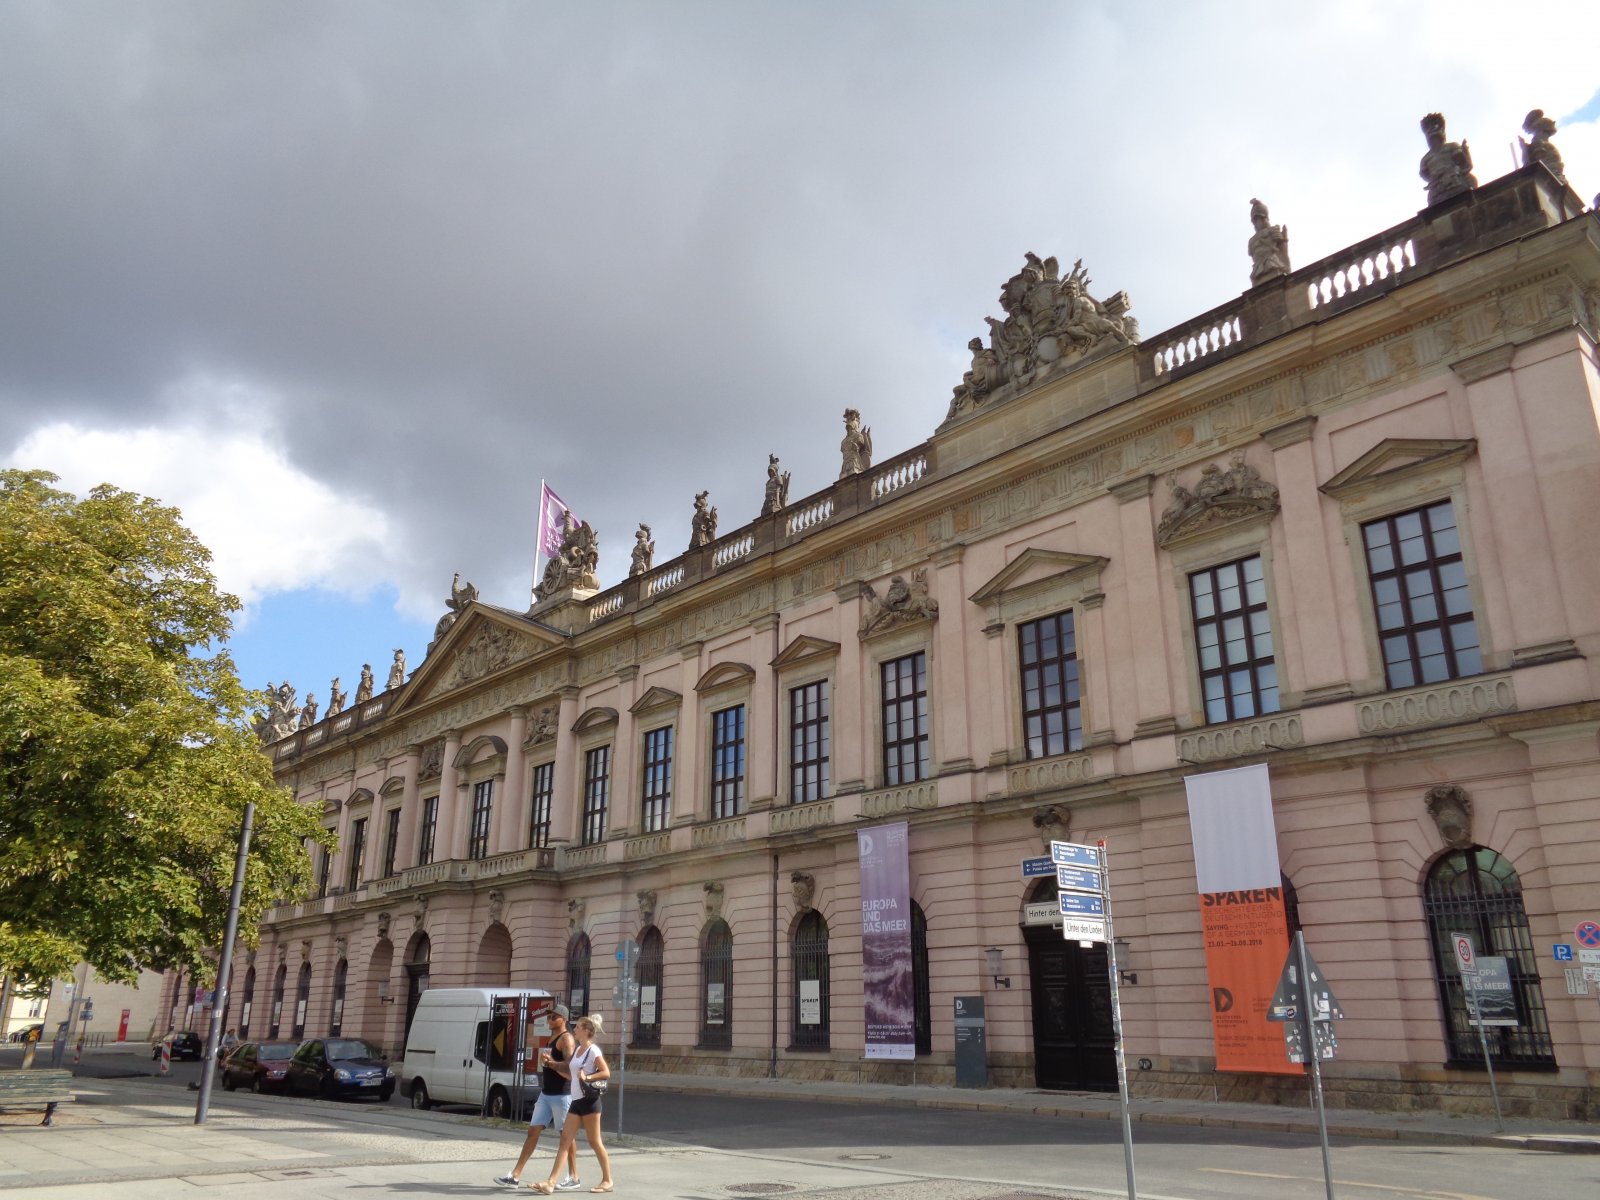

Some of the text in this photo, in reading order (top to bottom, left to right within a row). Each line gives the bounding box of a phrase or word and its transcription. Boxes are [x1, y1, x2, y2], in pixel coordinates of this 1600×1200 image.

[861, 835, 873, 857] D
[863, 898, 898, 911] EUROPA
[863, 911, 880, 922] UND
[864, 920, 906, 933] DAS MEER
[1066, 922, 1079, 932] Unter
[1089, 924, 1102, 934] Linden
[1461, 944, 1469, 956] 30
[1557, 946, 1567, 959] P
[1213, 988, 1234, 1012] D
